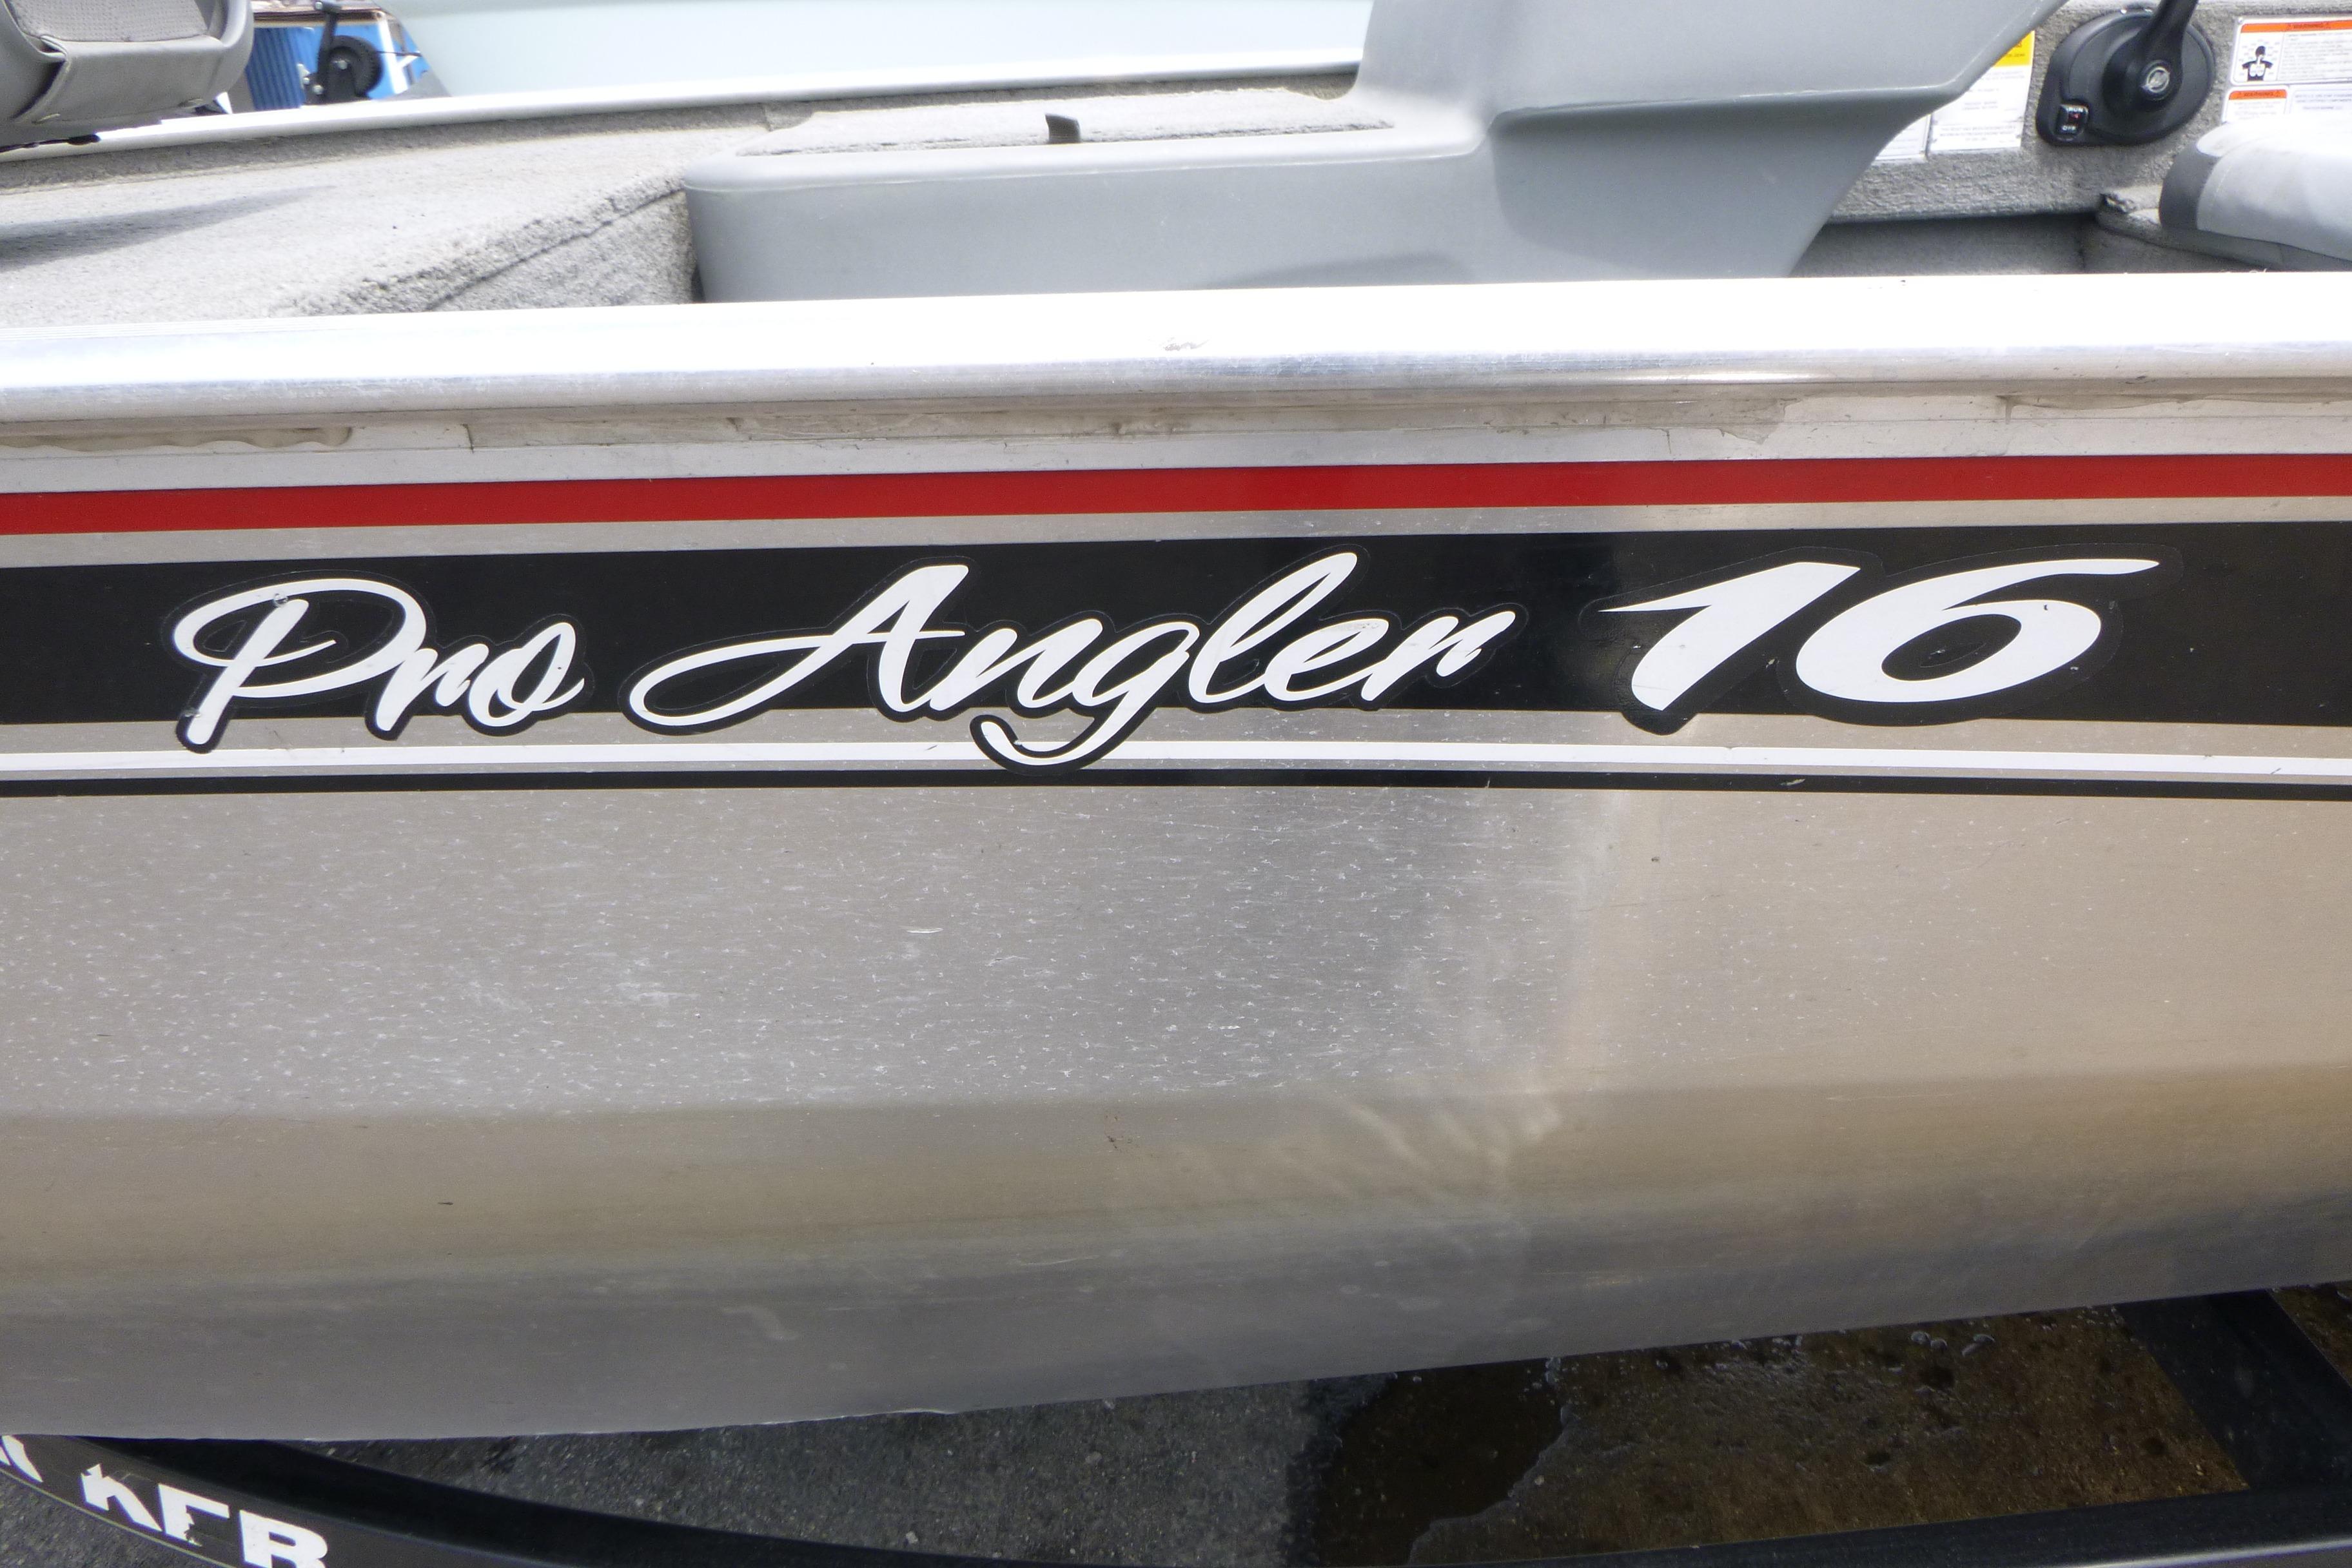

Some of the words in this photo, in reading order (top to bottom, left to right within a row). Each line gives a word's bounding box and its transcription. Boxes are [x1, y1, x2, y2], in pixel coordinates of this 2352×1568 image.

[173, 578, 585, 744] Pro
[629, 553, 1516, 765] Angler
[1598, 559, 2160, 710] 16
